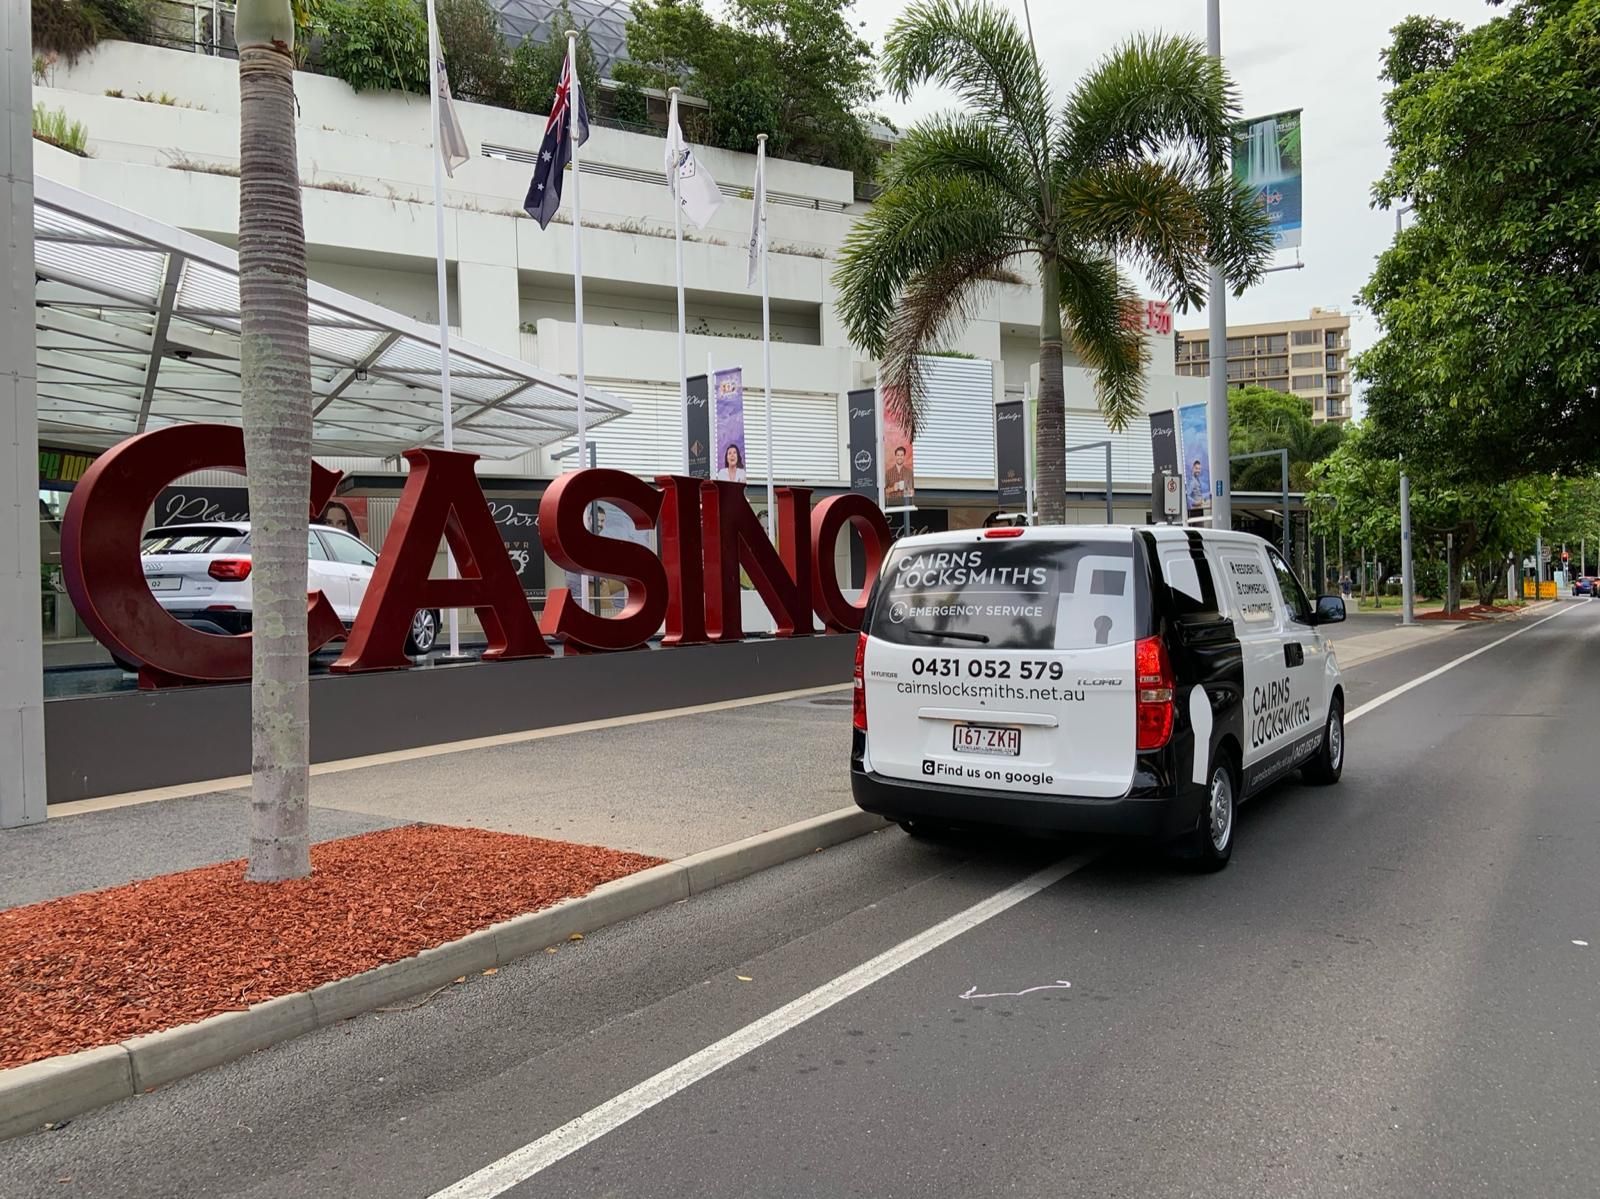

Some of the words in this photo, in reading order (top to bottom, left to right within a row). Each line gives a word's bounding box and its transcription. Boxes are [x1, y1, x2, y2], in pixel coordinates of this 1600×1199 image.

[687, 395, 706, 408] Play
[61, 423, 892, 691] CASINO
[898, 551, 982, 572] CAIRNS
[894, 567, 1047, 589] LOCKSMITHS
[909, 606, 982, 617] EMERGENCY
[986, 606, 1043, 617] SERVICE
[912, 657, 960, 677] 0431
[968, 659, 1011, 679] 052
[1019, 661, 1063, 681] 579
[897, 680, 1085, 702] cairnslocksmiths.net.au
[1253, 676, 1290, 716] CAIRNS
[1252, 696, 1310, 748] LOCKSMITHS
[937, 764, 963, 776] Find
[967, 768, 980, 778] us
[984, 769, 1001, 780] on
[1005, 772, 1054, 786] google
